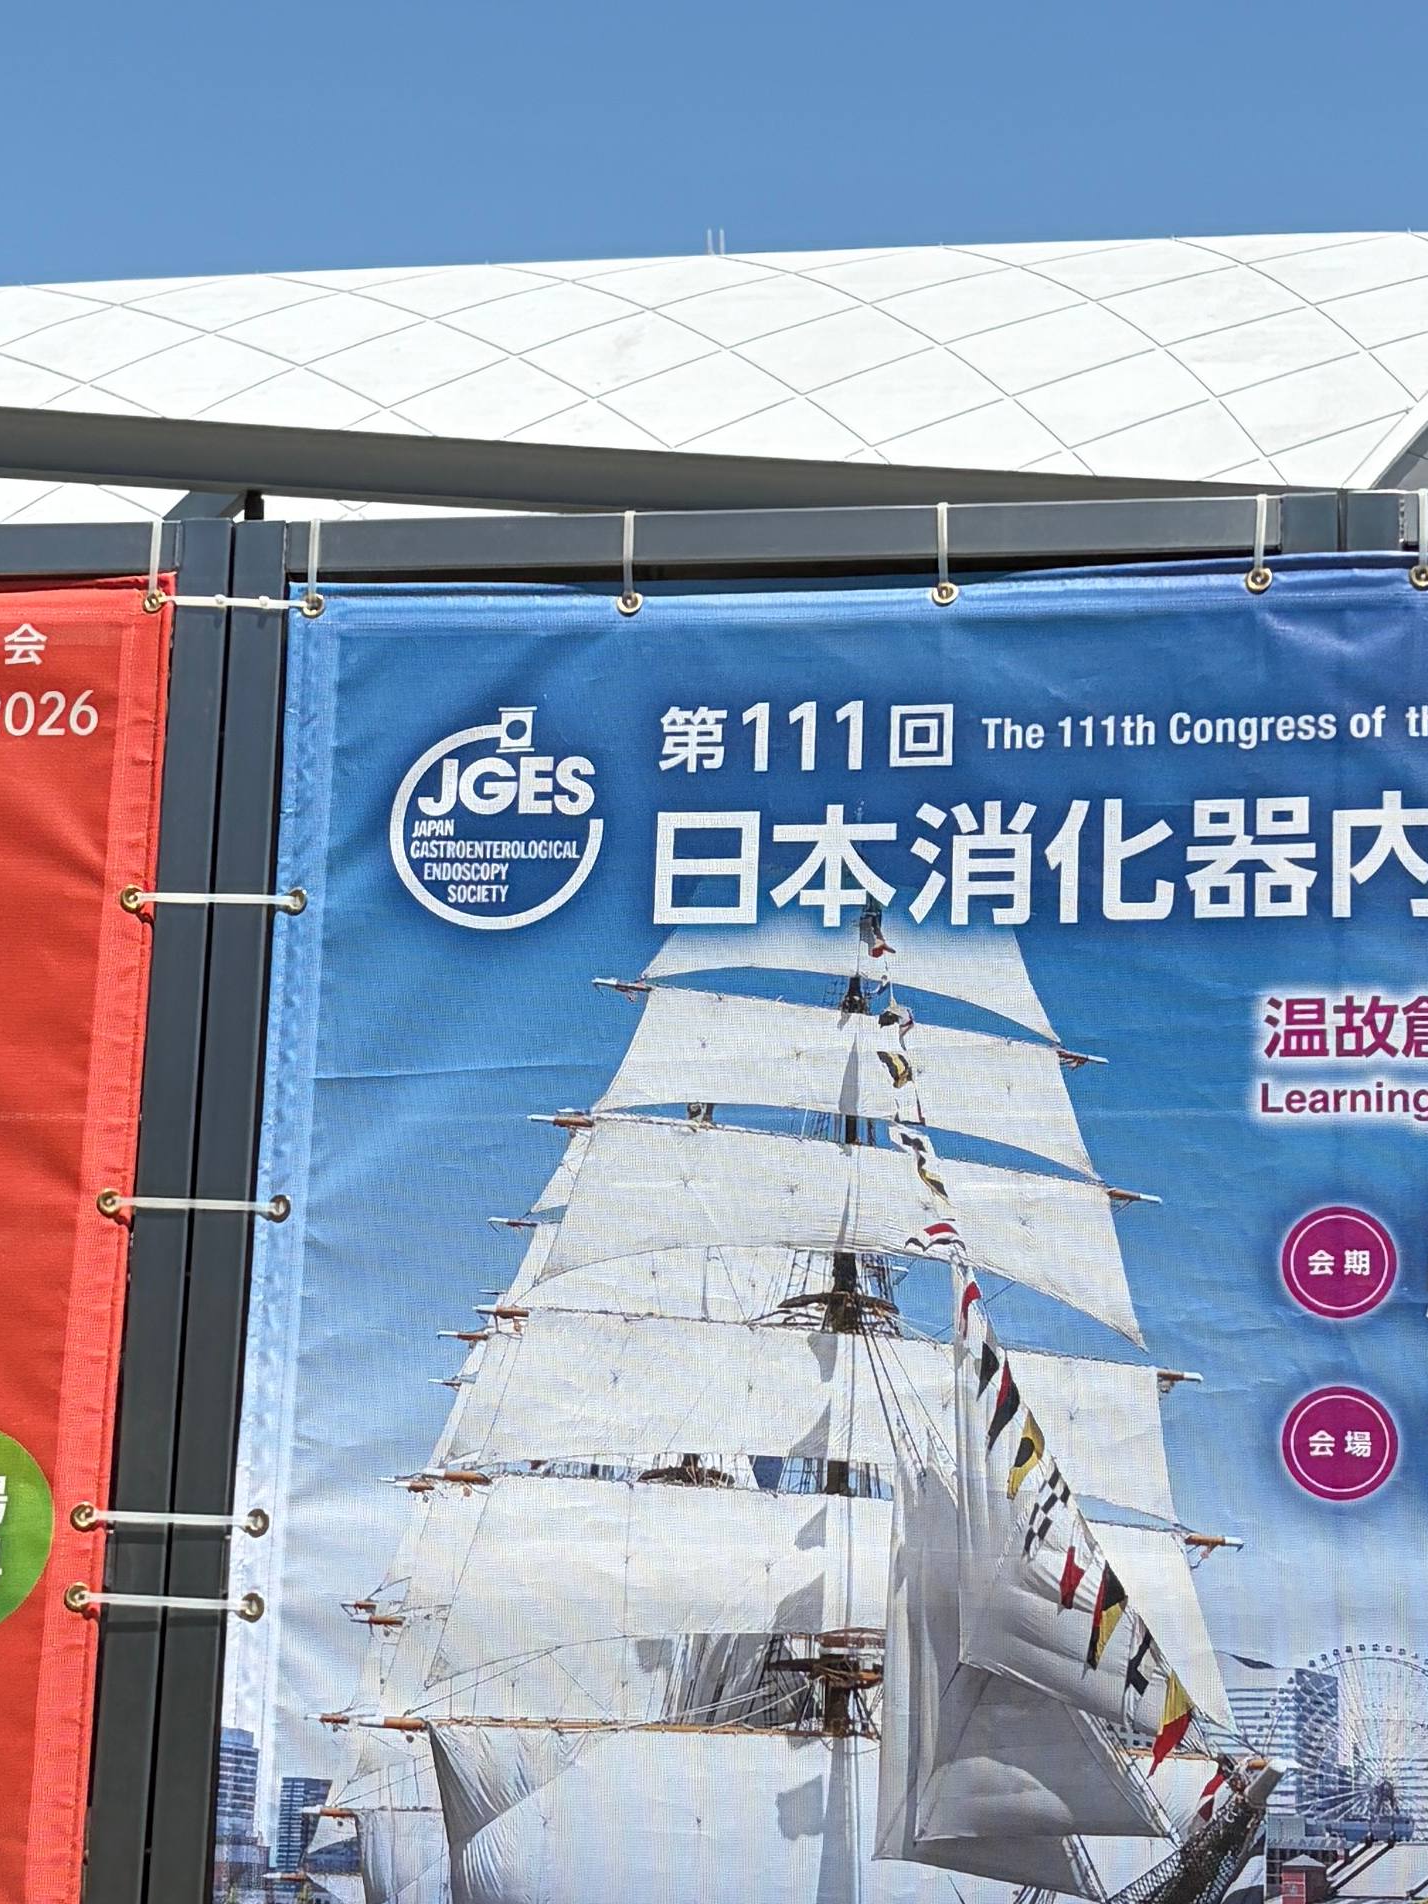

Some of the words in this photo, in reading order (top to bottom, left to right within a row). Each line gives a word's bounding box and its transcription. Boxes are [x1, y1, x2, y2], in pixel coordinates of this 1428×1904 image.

[659, 703, 954, 774] 第111回
[982, 717, 1047, 749] The
[1057, 715, 1155, 748] 111th
[1169, 711, 1338, 751] Congress
[1347, 707, 1386, 737] of
[418, 756, 595, 816] JGES
[412, 819, 454, 838] JAPAN
[410, 841, 580, 859] GASTROENTEROLOGICAL
[424, 863, 509, 881] ENDOSCOPY
[447, 885, 509, 903] SOCIETY
[1307, 1249, 1370, 1278] 会期
[1307, 1428, 1371, 1459] 会場
